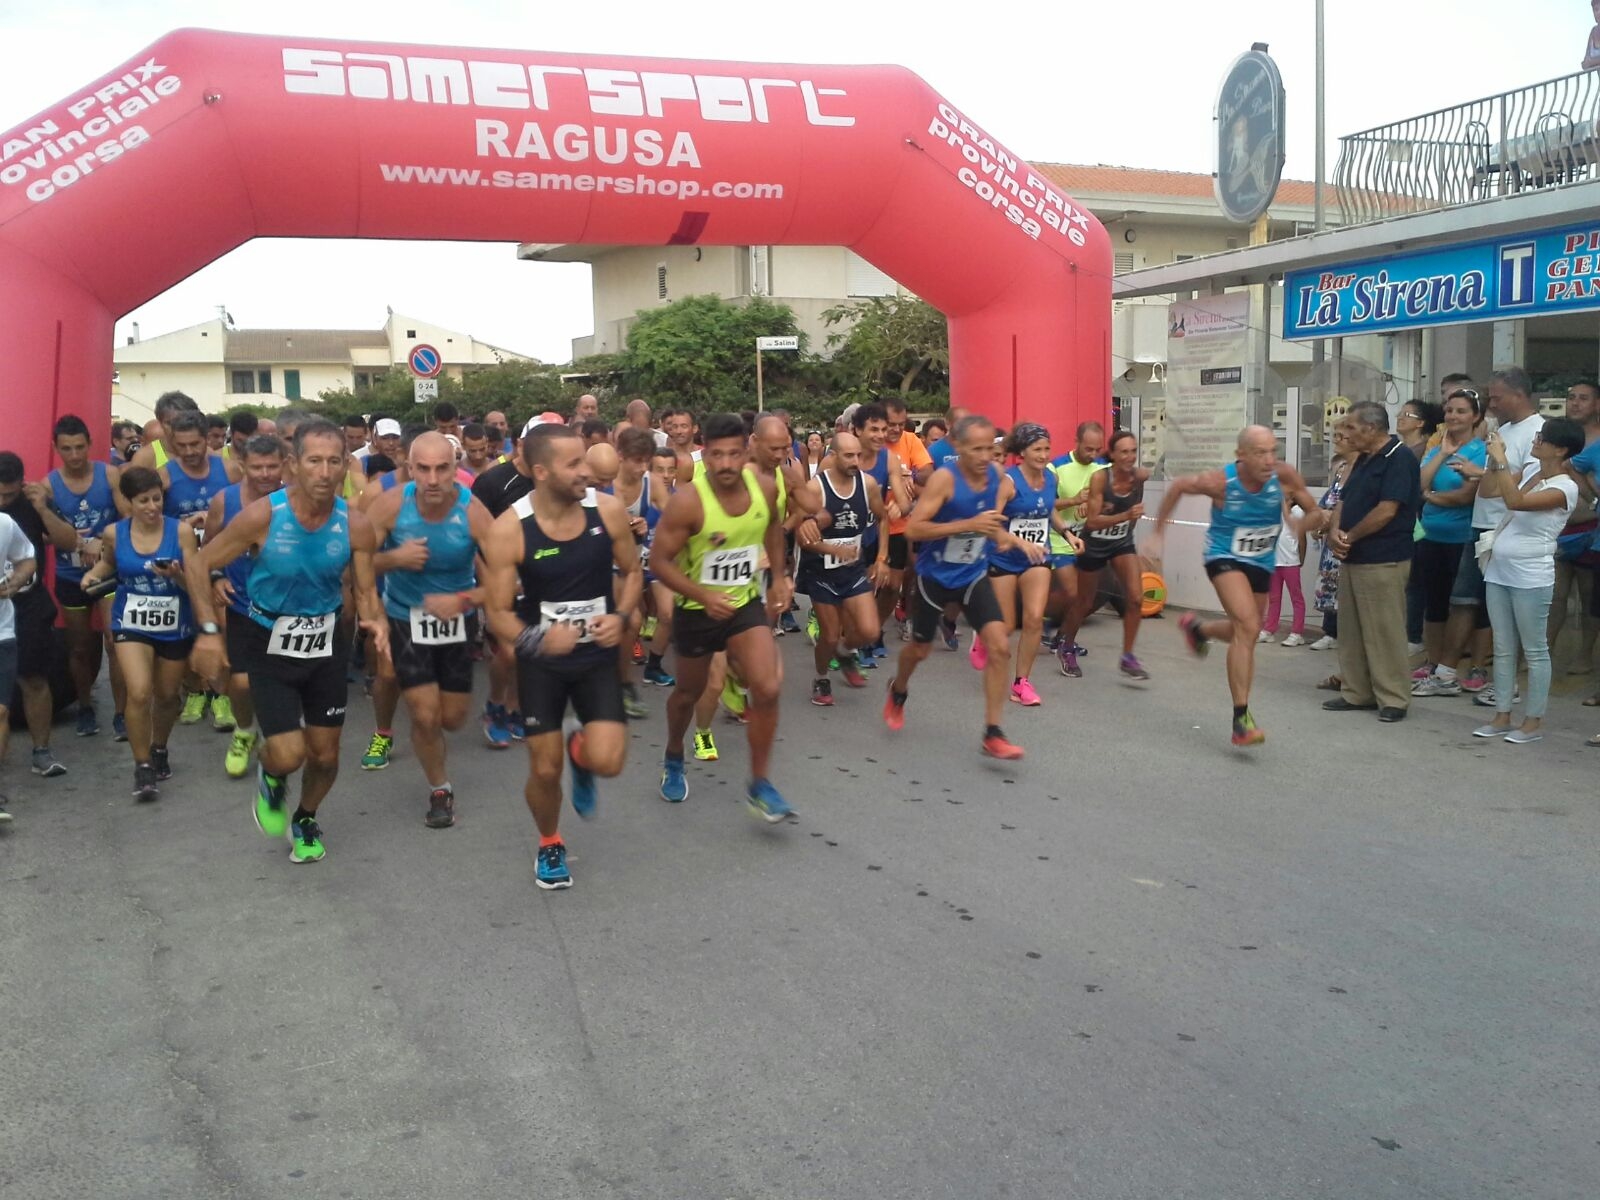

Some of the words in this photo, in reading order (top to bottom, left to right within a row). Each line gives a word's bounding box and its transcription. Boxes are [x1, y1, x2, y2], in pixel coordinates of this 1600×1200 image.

[0, 119, 59, 162] AN
[67, 57, 167, 119] PRIX
[26, 125, 150, 201] corsa
[475, 118, 701, 168] RAGUSA
[379, 164, 783, 200] www.samershop.com
[928, 116, 1086, 246] provinciale
[938, 103, 1017, 173] GRAN
[1026, 172, 1090, 232] PRIX
[957, 167, 1042, 240] corsa
[1317, 270, 1356, 291] Bar
[1547, 253, 1600, 278] GE
[1296, 285, 1341, 328] La
[1351, 269, 1486, 324] Sirena
[709, 560, 752, 581] 1114
[128, 608, 176, 627] 1156
[419, 616, 459, 639] 1147
[280, 631, 327, 653] 1174
